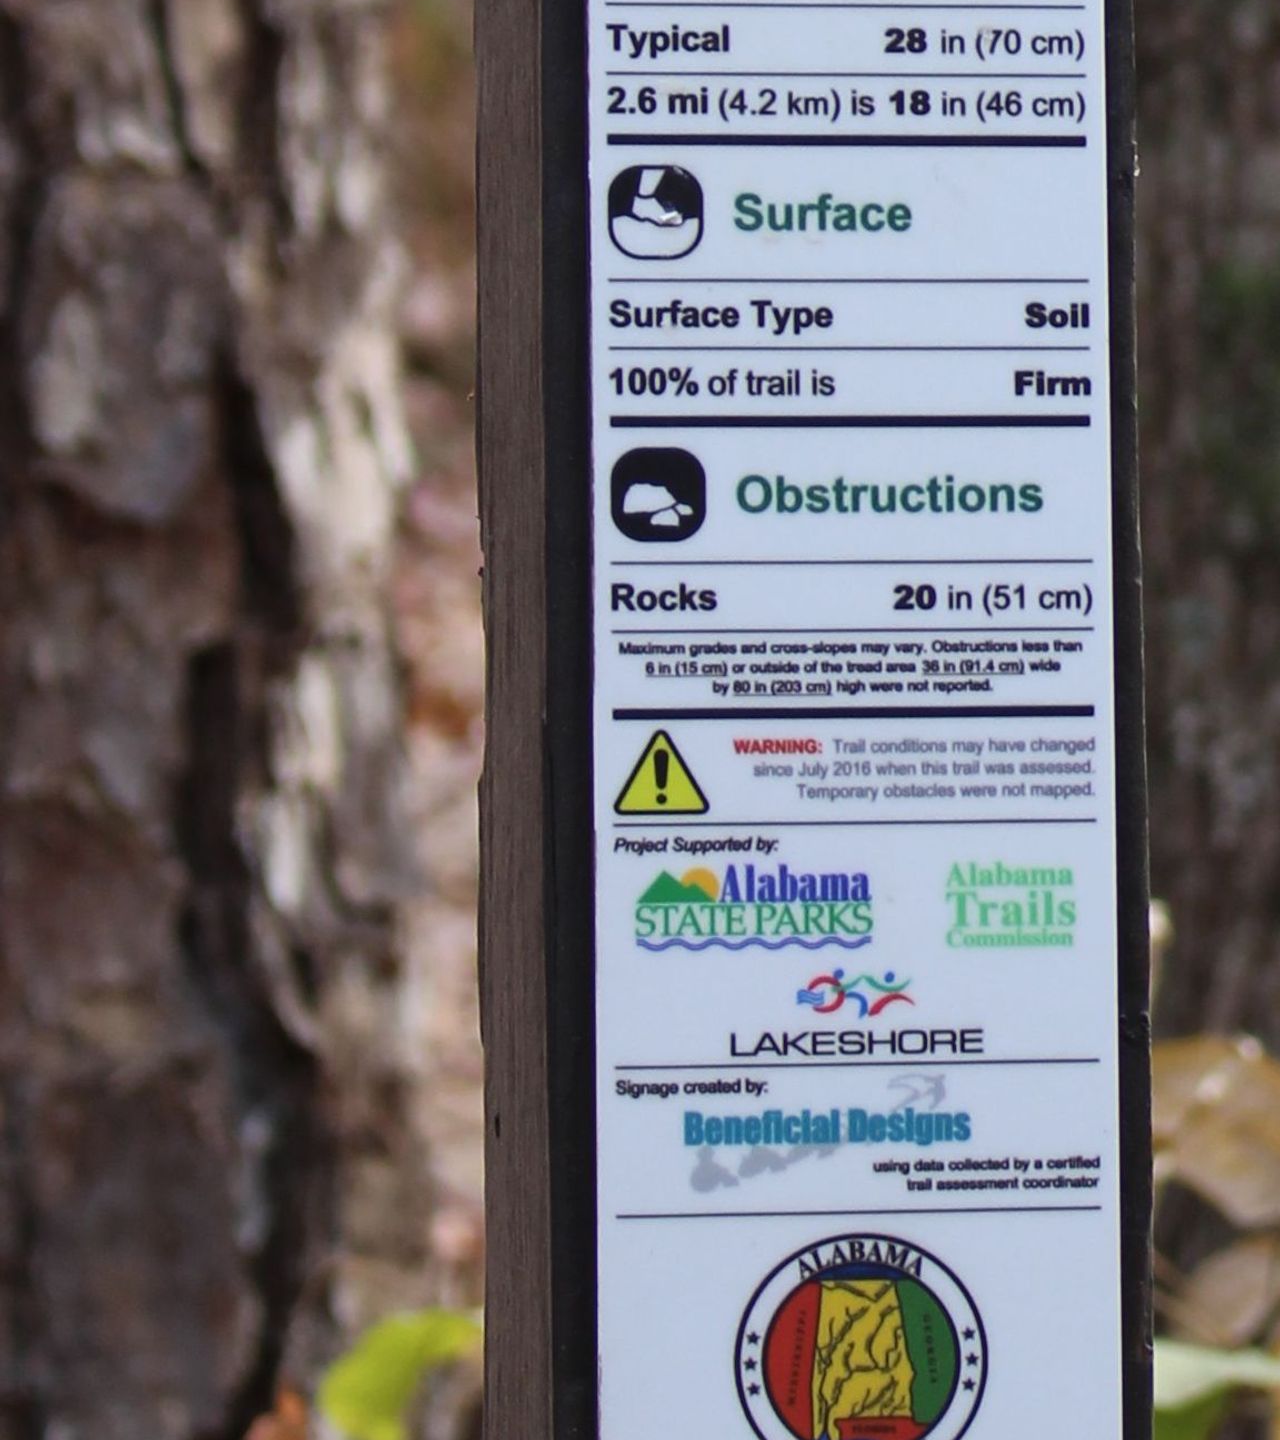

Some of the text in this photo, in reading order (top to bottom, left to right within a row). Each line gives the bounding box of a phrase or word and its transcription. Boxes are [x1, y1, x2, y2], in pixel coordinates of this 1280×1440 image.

[605, 23, 1085, 61] Typical 28 in (70 cm)
[606, 85, 1086, 124] 2.6 mi (4.2 km) is 18 in (46 cm)
[733, 192, 913, 233] Surface
[608, 298, 1091, 337] Surface Type Soil
[608, 366, 1092, 397] 100% of trail is Firm
[735, 474, 1044, 515] Obstructions
[610, 582, 1093, 617] Rocks 20 in (51 cm)
[613, 835, 780, 857] Project Supported by:
[719, 863, 872, 903] Alabama
[945, 861, 1075, 889] Alabama
[634, 899, 874, 939] STATE PARKS
[945, 891, 1077, 929] Trails
[945, 930, 1075, 949] Commission
[729, 1028, 985, 1058] LAKESHORE
[615, 1077, 769, 1100] Signage created by:
[683, 1107, 972, 1149] Beneficial Designs
[797, 1239, 926, 1280] ALABAMA
